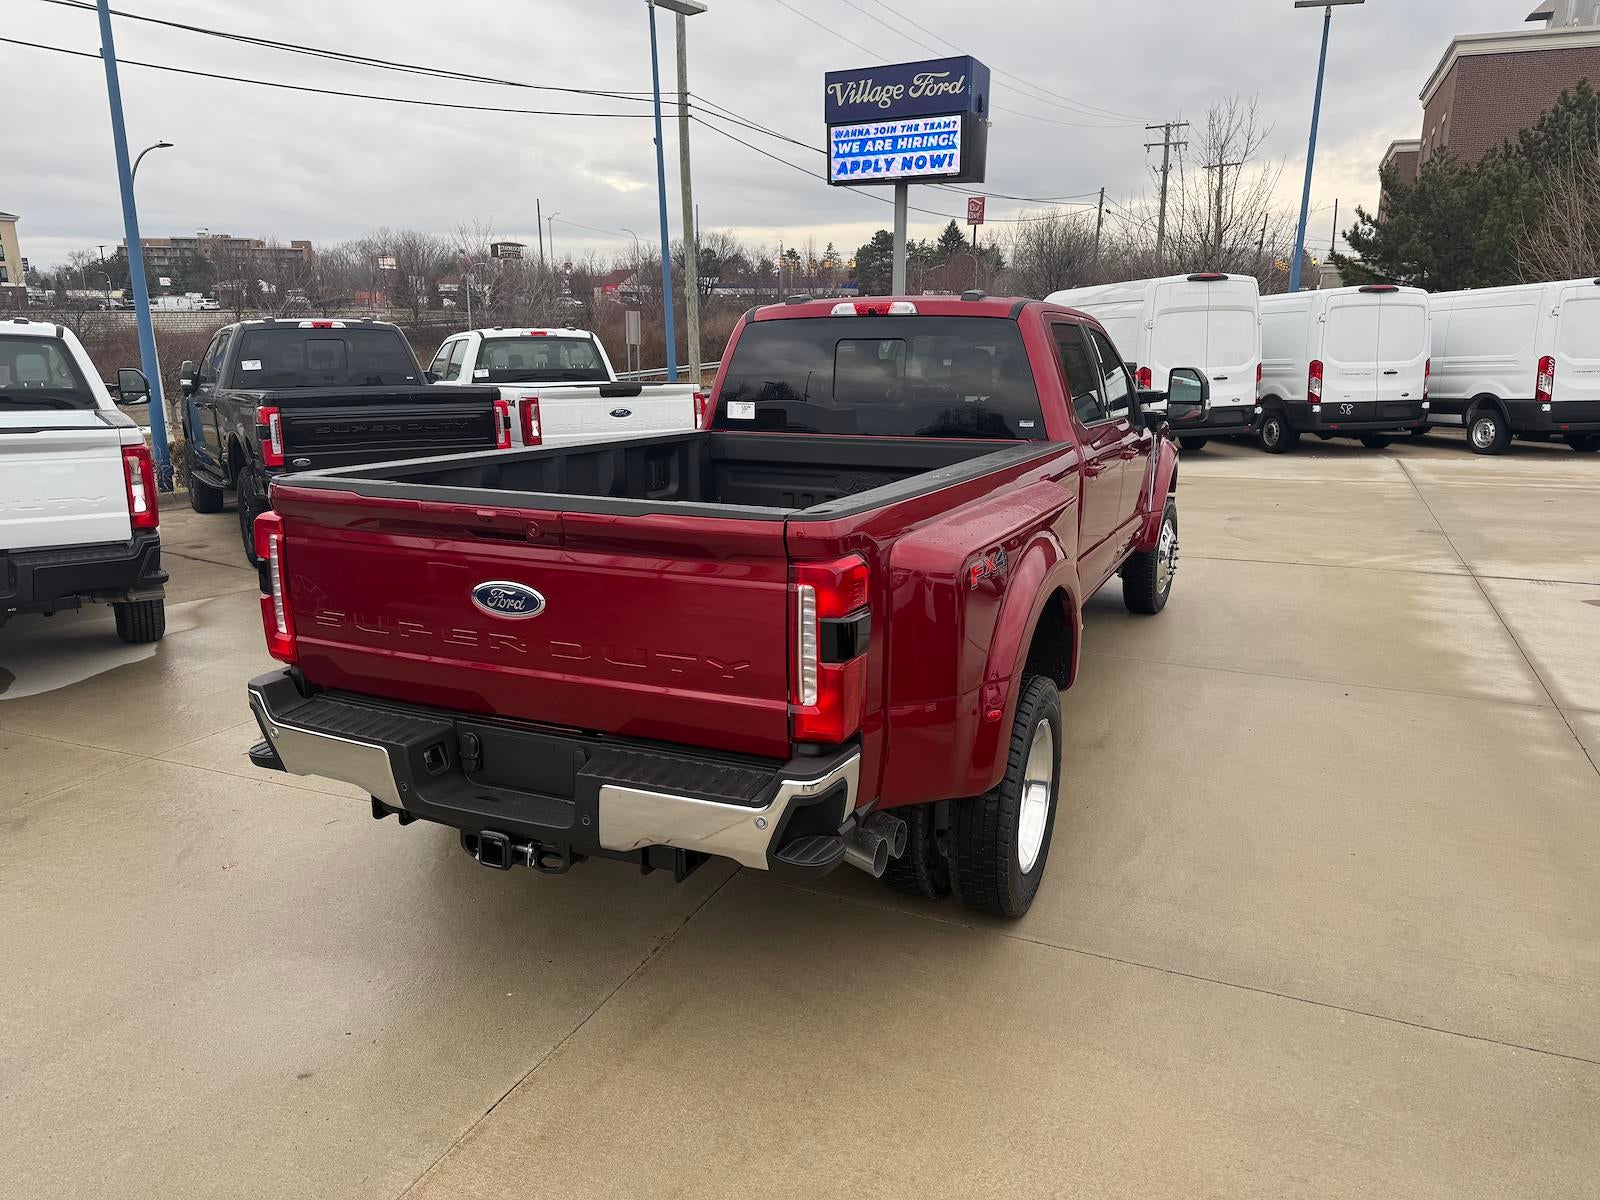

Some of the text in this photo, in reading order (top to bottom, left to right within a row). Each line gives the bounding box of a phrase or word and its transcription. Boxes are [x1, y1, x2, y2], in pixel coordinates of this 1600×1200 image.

[827, 71, 966, 109] Village Ford
[835, 120, 958, 139] WANNA JOIN THE TEAM?
[837, 133, 955, 154] WE ARE HIRING!
[836, 153, 955, 175] APPLY NOW!
[1340, 403, 1354, 415] 58
[971, 547, 1008, 590] FX4
[486, 588, 526, 611] Ford
[315, 610, 751, 679] SUPER DUTY
